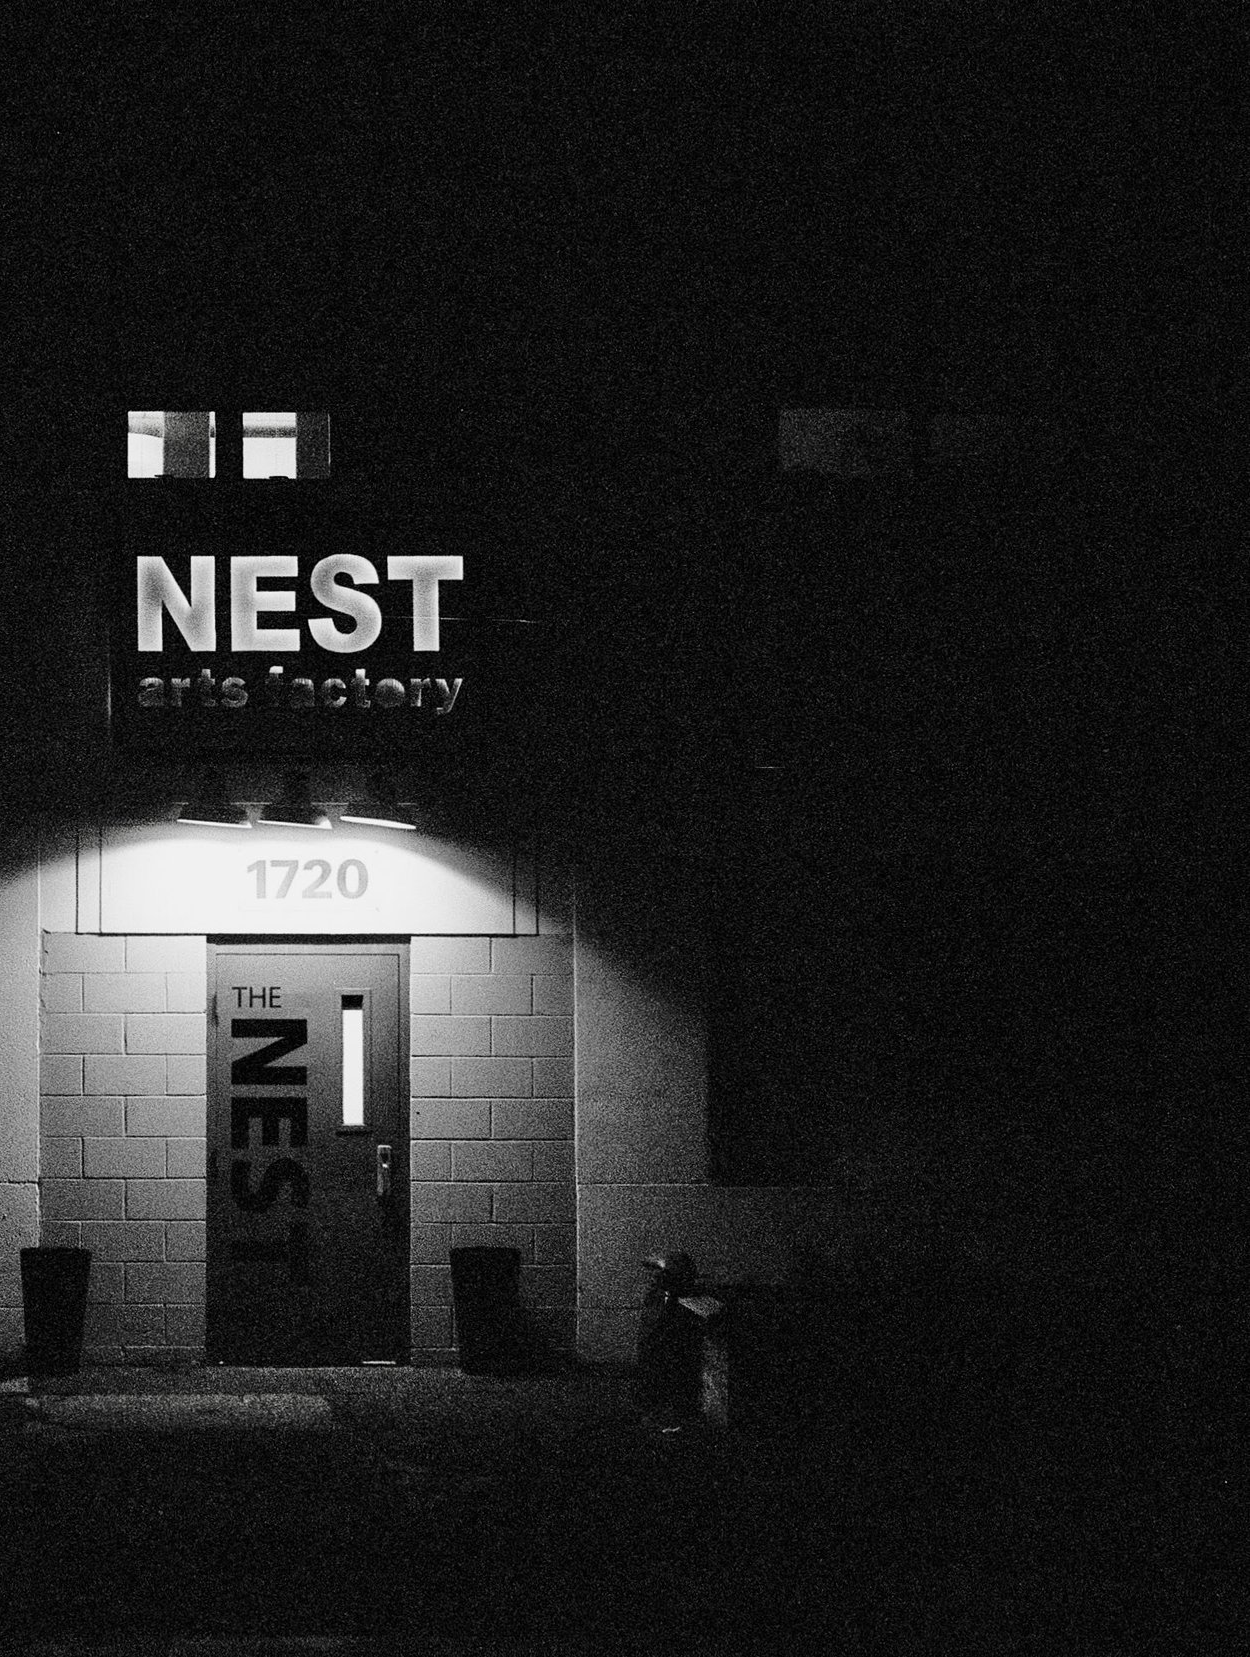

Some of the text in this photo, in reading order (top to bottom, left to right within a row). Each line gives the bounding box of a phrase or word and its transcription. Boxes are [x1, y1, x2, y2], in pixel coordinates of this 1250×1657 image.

[137, 553, 464, 652] NEST
[137, 664, 464, 715] arts factory
[247, 858, 369, 899] 1720
[232, 986, 282, 1008] THE
[232, 1020, 310, 1286] NEST
